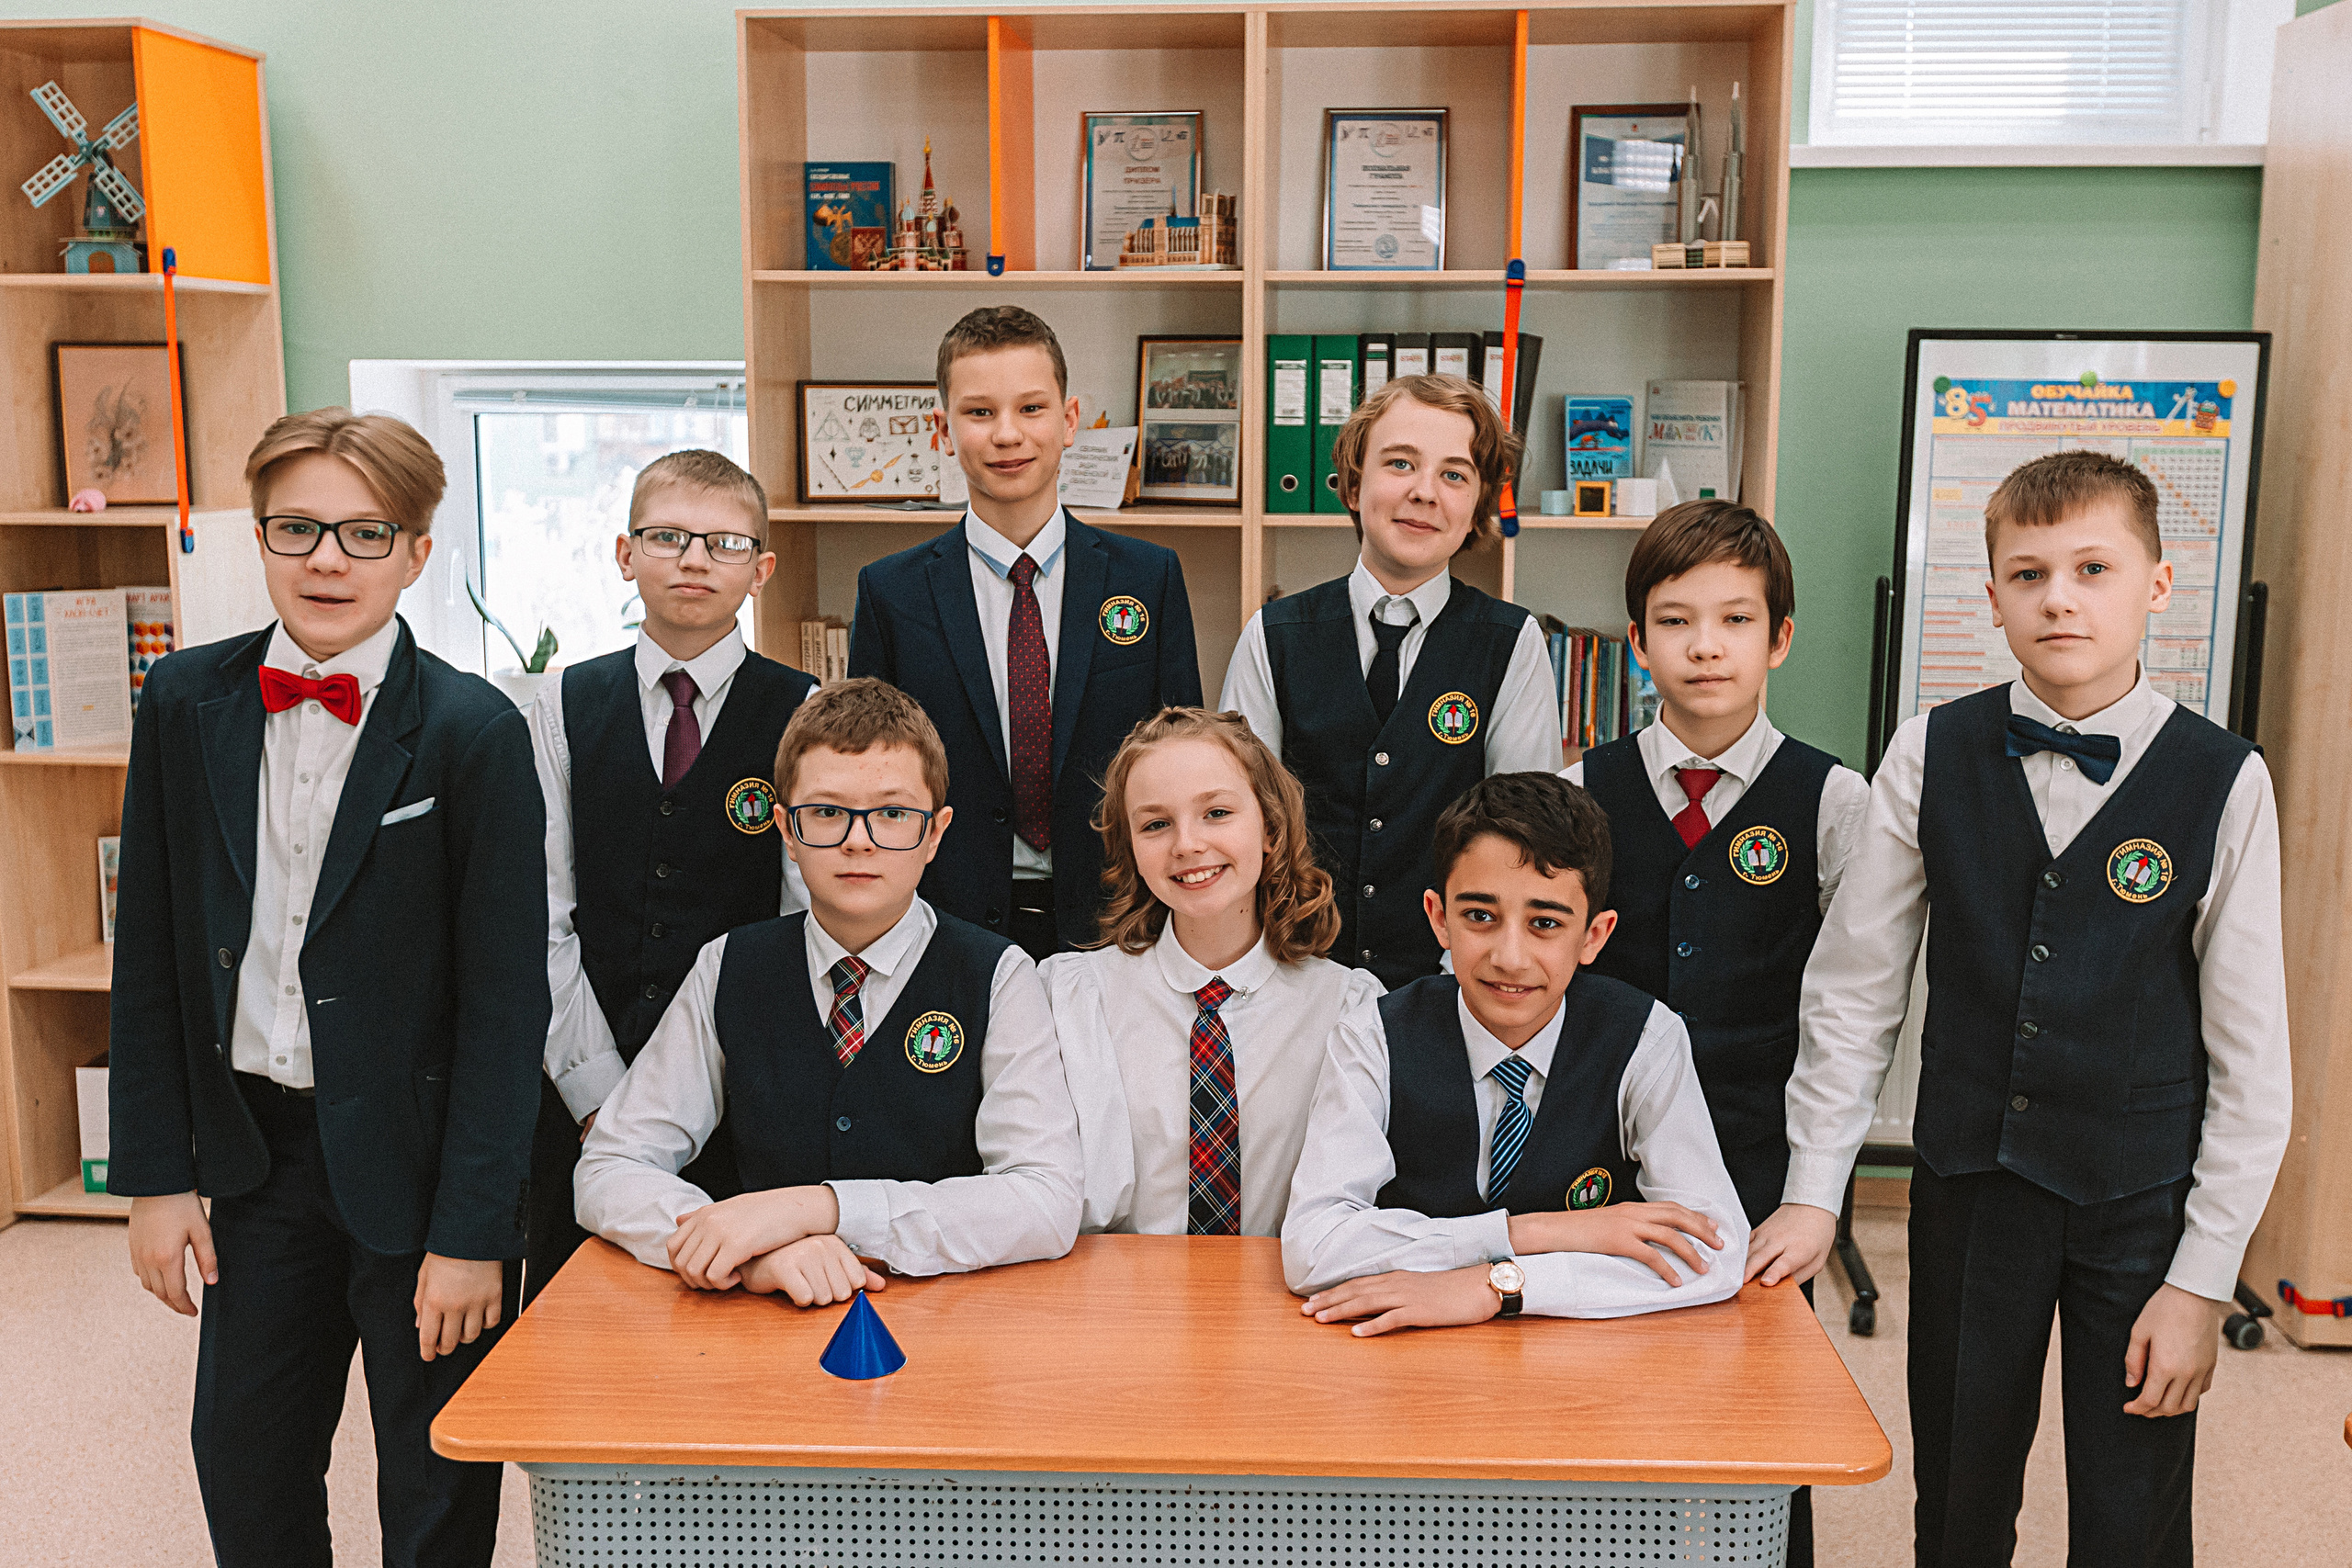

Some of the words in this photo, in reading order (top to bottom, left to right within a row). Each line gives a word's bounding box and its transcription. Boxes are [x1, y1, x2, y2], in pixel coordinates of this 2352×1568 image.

[2030, 382, 2134, 400] ОБУЧАЙКА
[843, 394, 936, 412] СИММЕТРИЯ
[2007, 400, 2157, 419] МАТЕМАТИКА
[1997, 421, 2098, 434] ПРОДВИНУТЫЙ
[2101, 422, 2164, 434] УРОВЕНЬ
[1569, 460, 1614, 477] ЗАДАЧИ
[1102, 599, 1135, 616] ГИМНАЗИЯ
[1431, 694, 1464, 717] ГИМНАЗИЯ
[729, 782, 760, 808] ГИМНАЗИЯ
[1733, 829, 1767, 858] ГИМНАЗИЯ
[2115, 842, 2164, 860] ГИМНАЗИЯ
[2159, 858, 2168, 870] №
[2160, 871, 2169, 882] 16
[910, 1015, 949, 1039] ГИМНАЗИЯ
[953, 1033, 960, 1044] 16
